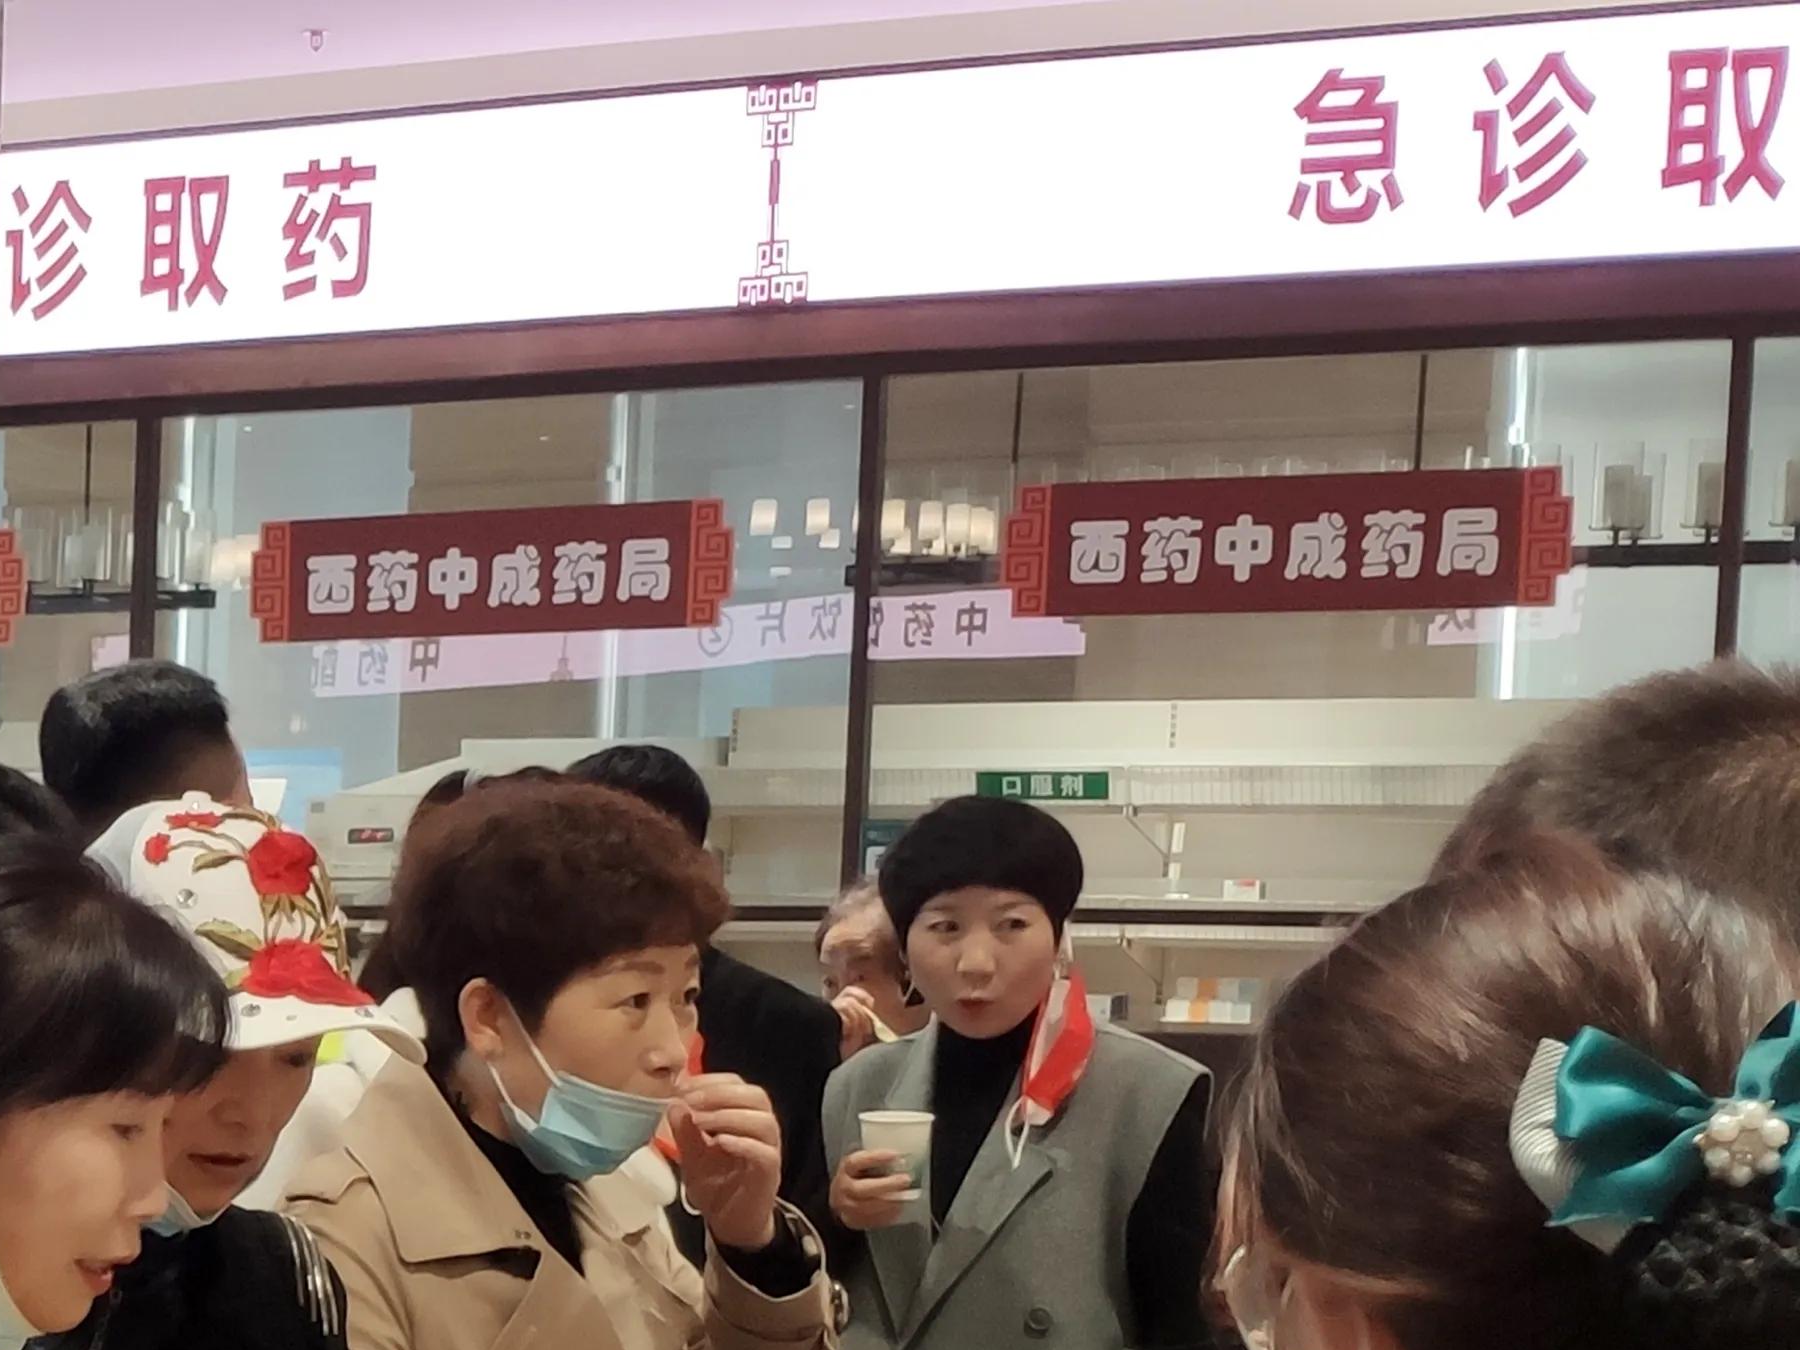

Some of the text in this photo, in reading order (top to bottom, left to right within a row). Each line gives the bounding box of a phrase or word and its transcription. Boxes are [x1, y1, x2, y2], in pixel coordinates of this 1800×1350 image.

[1287, 46, 1790, 224] 急诊取
[5, 157, 377, 321] 诊取药
[305, 537, 672, 616] 西药中成药局
[1067, 506, 1501, 586] 西药中成药局
[1002, 773, 1084, 798] 口服剂
